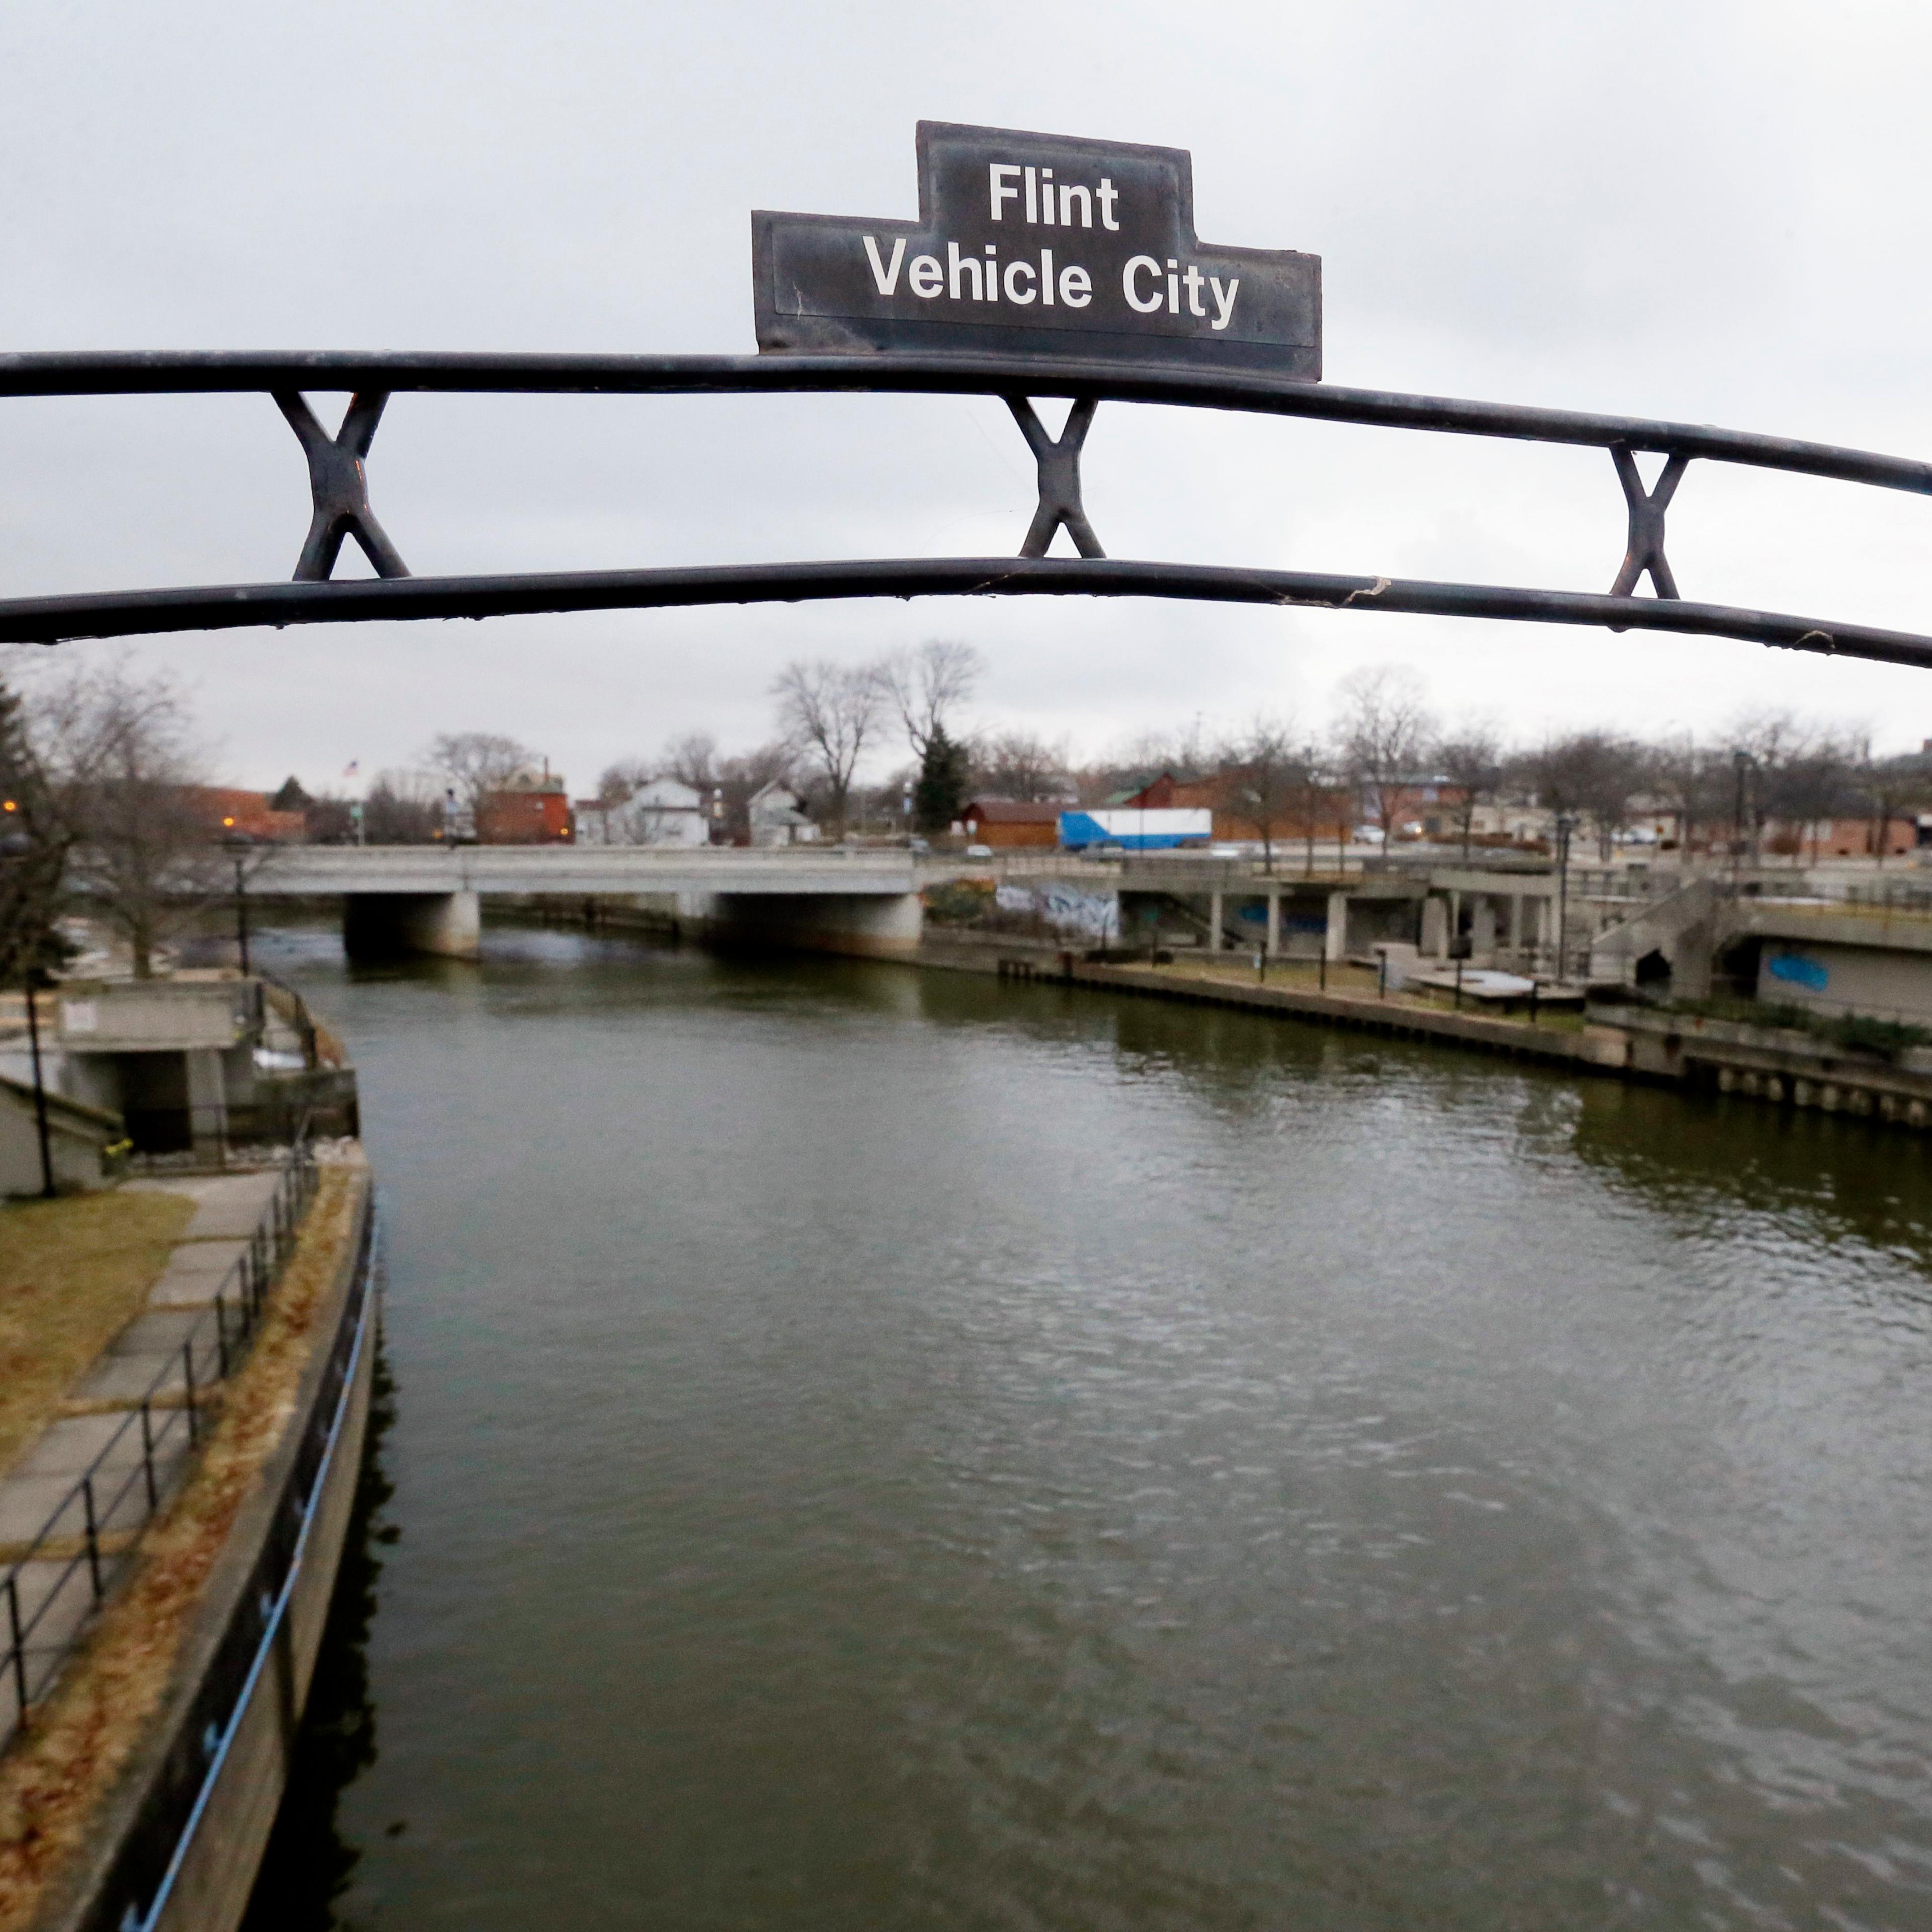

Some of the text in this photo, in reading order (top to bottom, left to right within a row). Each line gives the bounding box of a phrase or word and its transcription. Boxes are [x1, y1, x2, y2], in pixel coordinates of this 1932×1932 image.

[989, 163, 1119, 231] Flint
[862, 236, 1240, 330] Vehicle City
